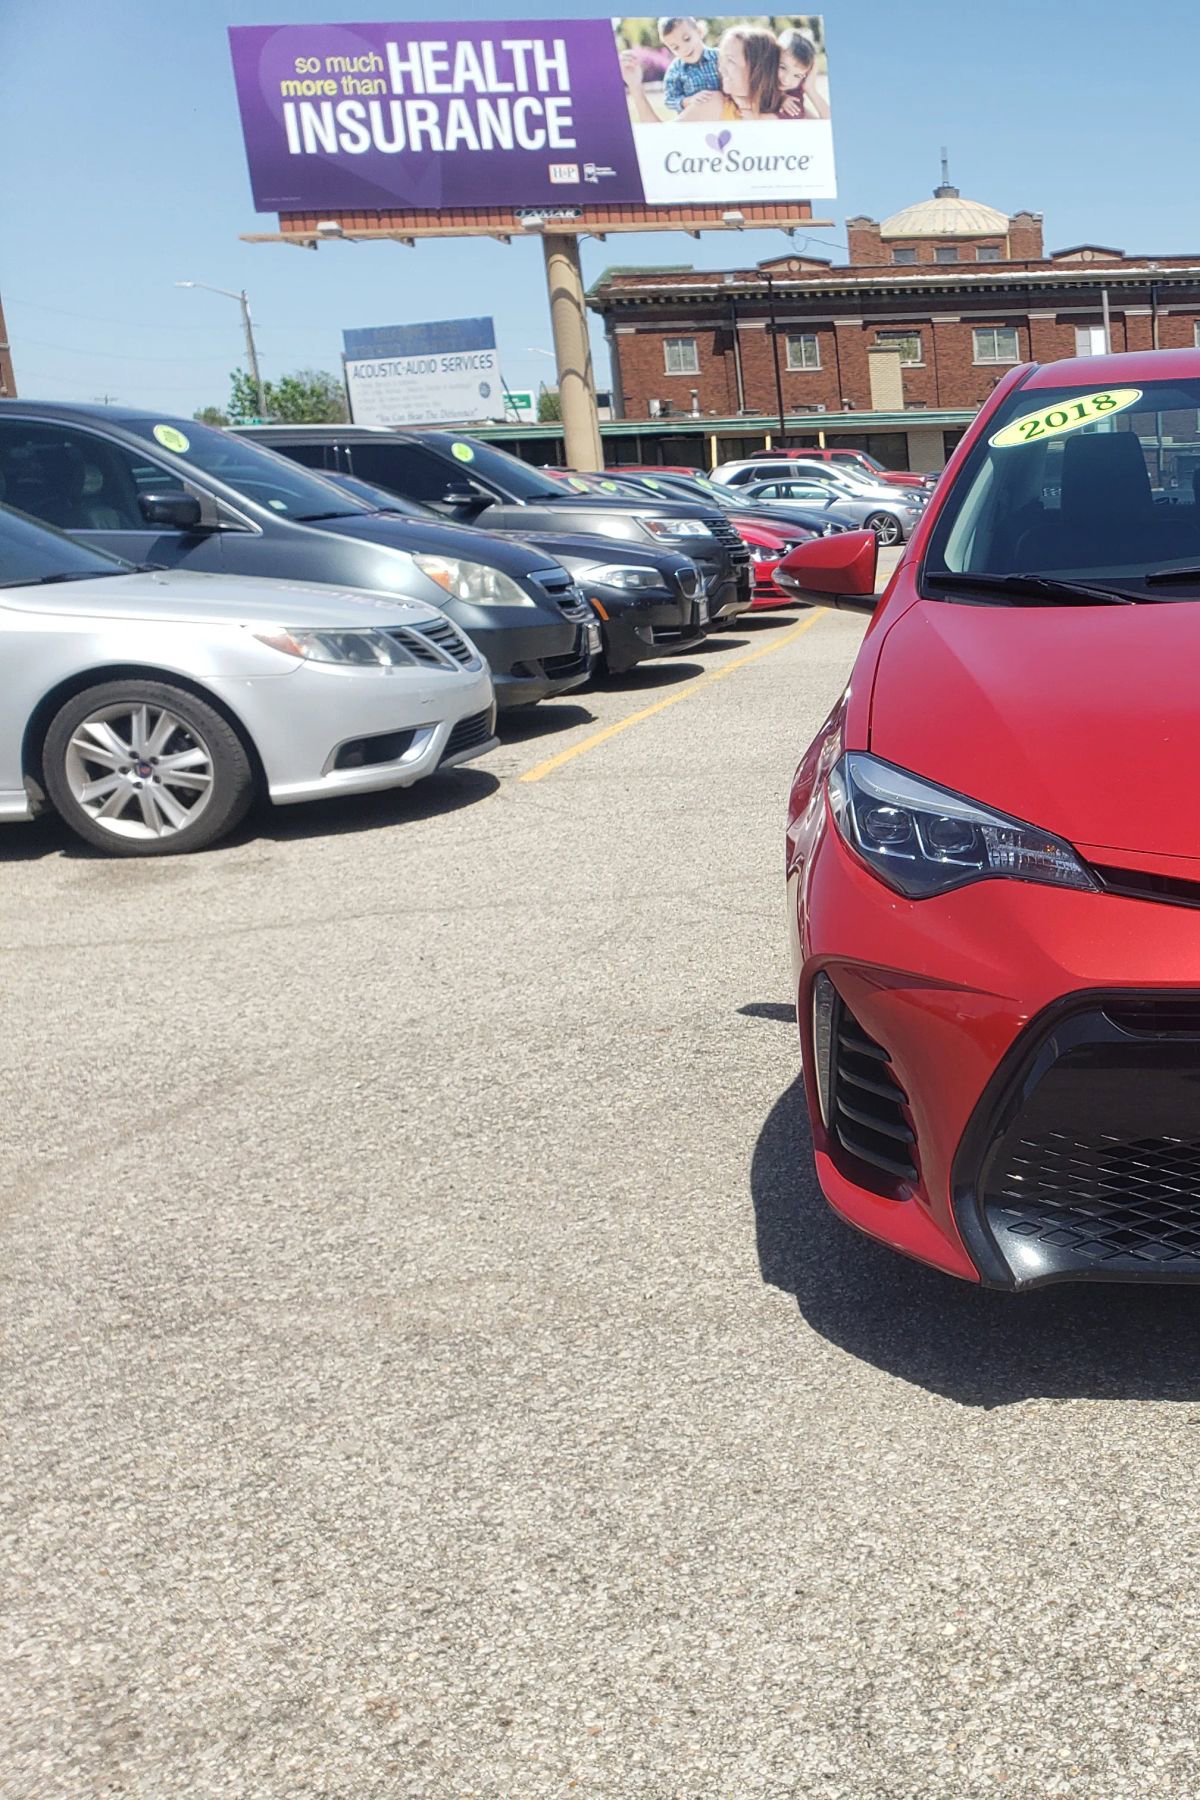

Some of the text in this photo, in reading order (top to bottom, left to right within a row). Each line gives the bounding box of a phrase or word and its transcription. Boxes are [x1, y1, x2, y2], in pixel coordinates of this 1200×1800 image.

[294, 51, 385, 74] so much
[385, 38, 571, 95] HEALTH
[280, 75, 387, 97] more than
[282, 96, 577, 154] INSURANCE
[664, 149, 811, 174] CareSource
[440, 353, 494, 373] SERVICES
[1019, 394, 1118, 440] 2018
